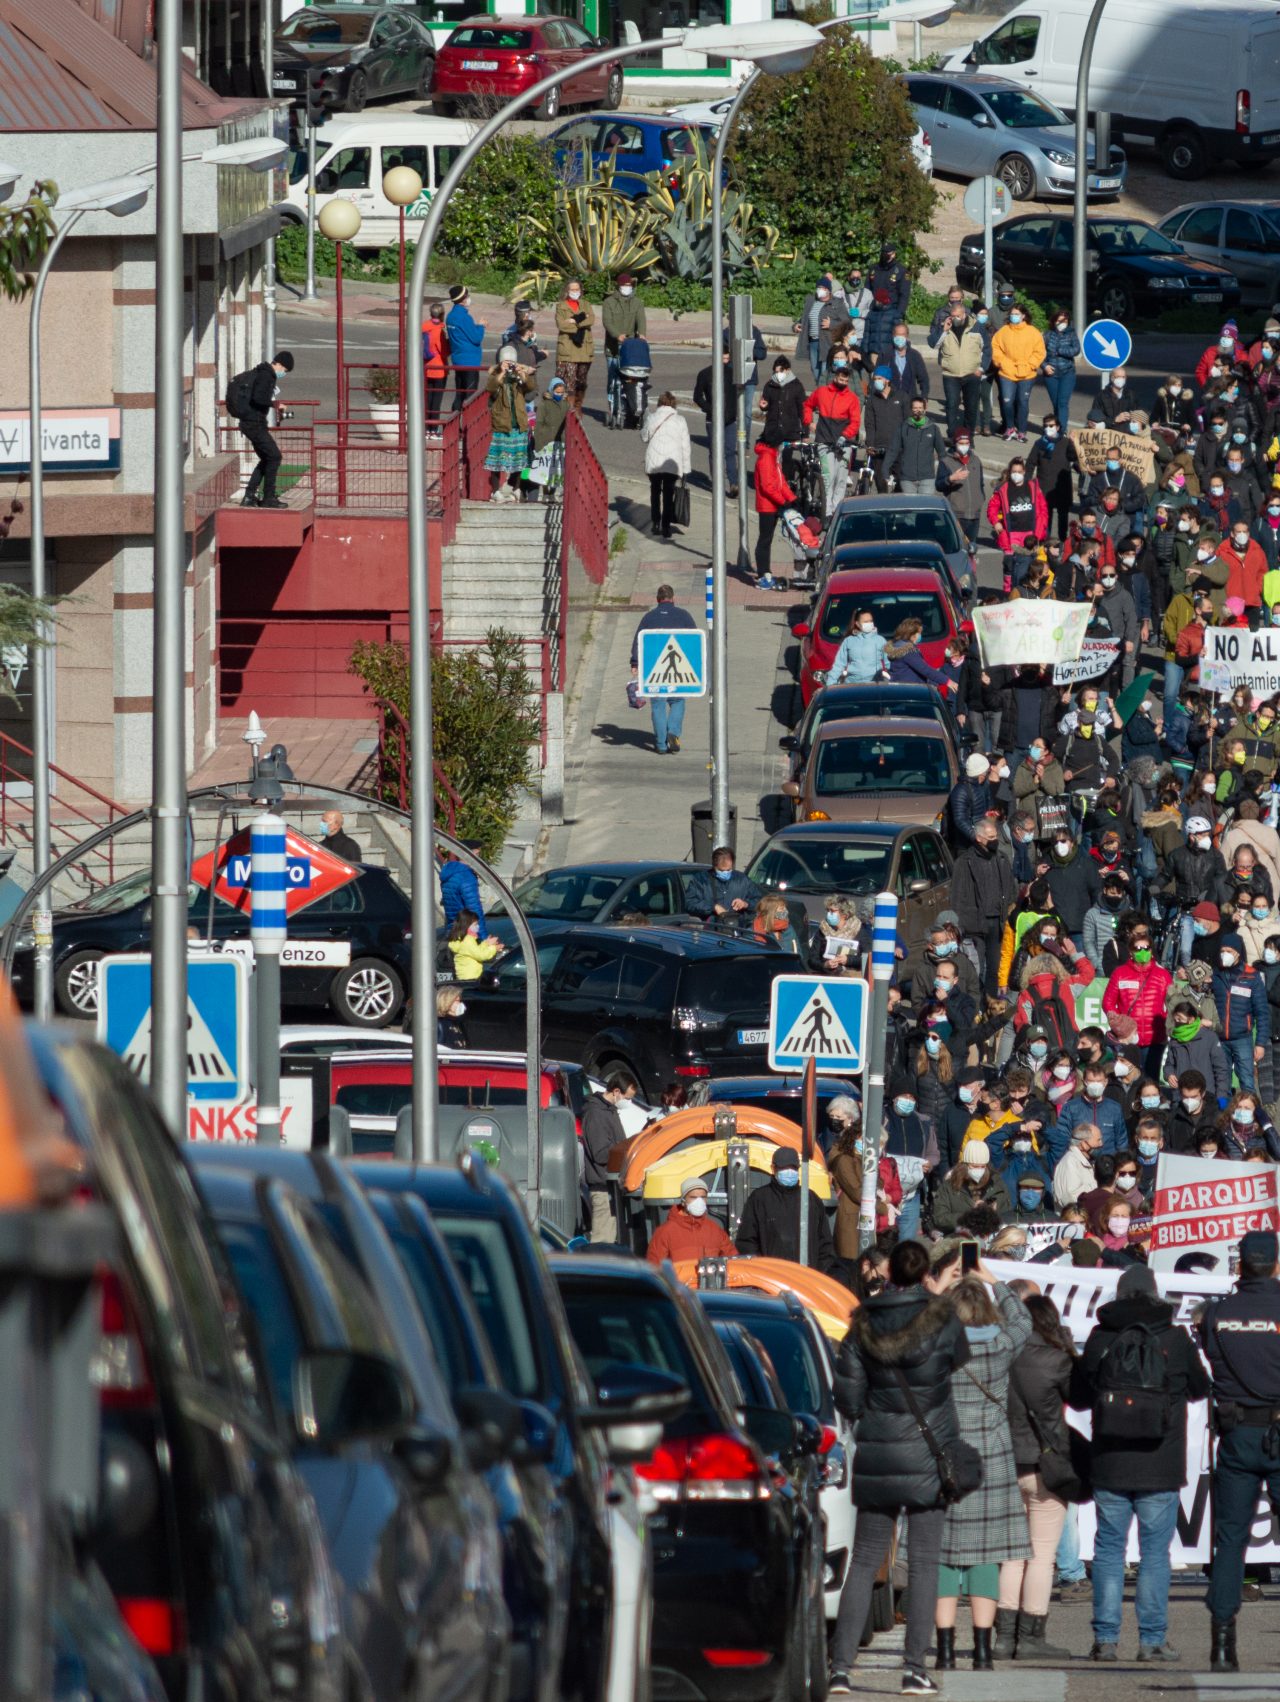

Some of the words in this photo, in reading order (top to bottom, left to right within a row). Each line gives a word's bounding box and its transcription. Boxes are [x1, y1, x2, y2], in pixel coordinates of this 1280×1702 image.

[41, 429, 101, 450] ivanta
[1082, 642, 1119, 652] ULADORA
[1215, 634, 1239, 661] NO
[1251, 635, 1277, 662] AL
[745, 1032, 767, 1042] 4677
[190, 1105, 292, 1140] NKSY
[1167, 1177, 1269, 1212] PARQUE
[1158, 1214, 1273, 1246] BIBLIOTECA
[1217, 1320, 1277, 1333] POLICIA
